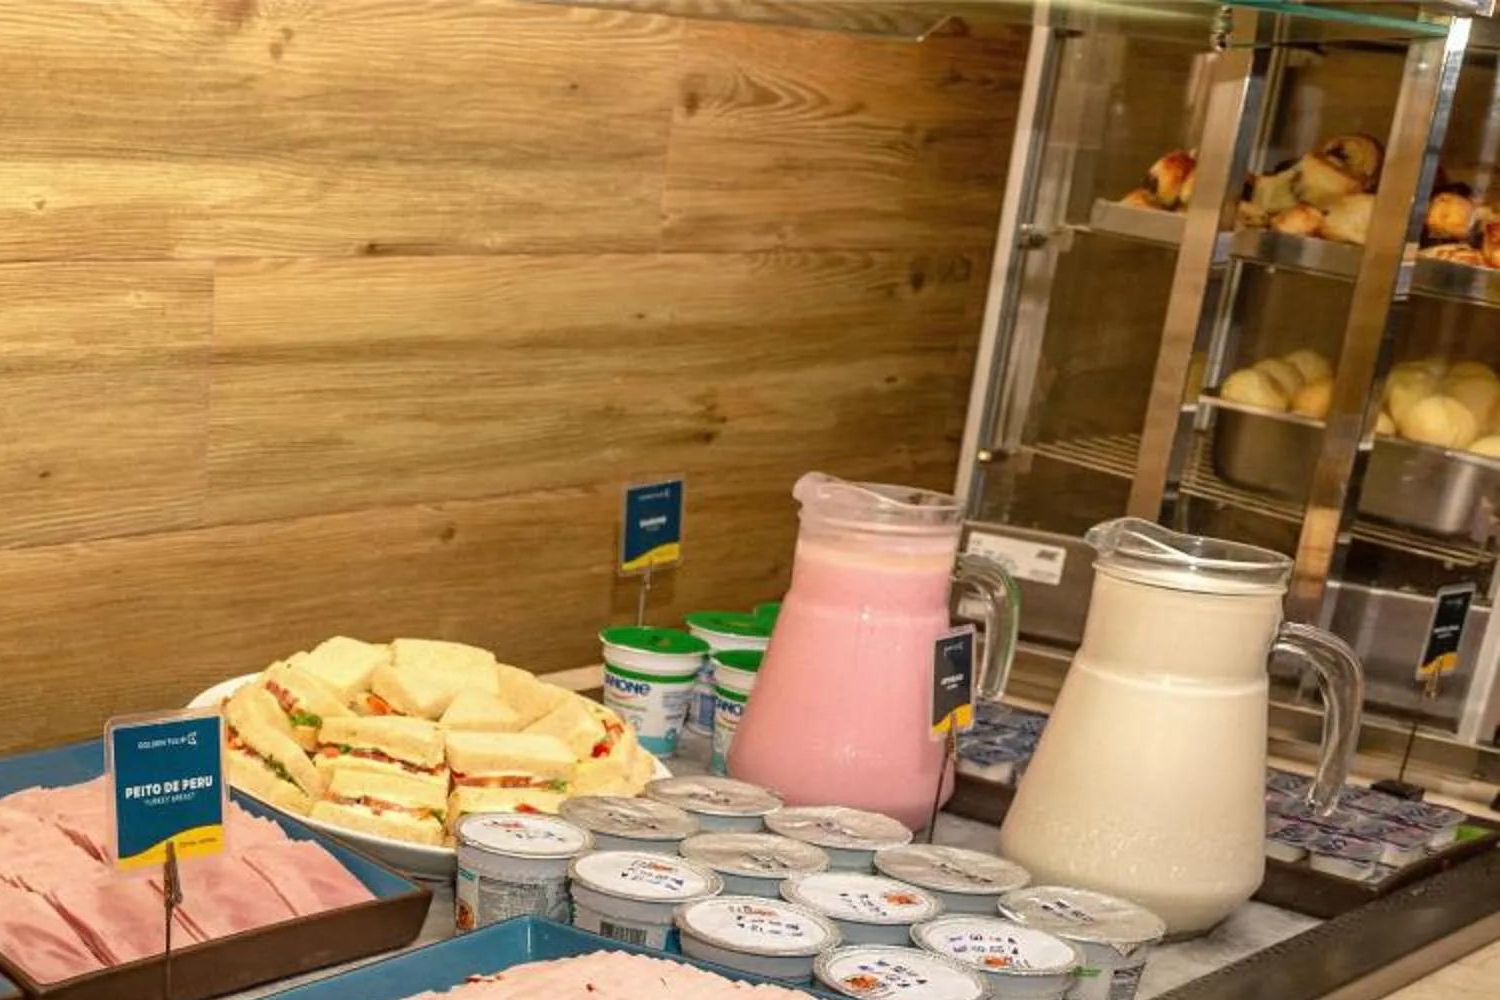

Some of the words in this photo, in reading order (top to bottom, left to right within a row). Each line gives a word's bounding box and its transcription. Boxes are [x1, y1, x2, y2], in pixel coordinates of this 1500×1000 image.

[125, 782, 162, 799] PEITO
[163, 779, 180, 794] DE
[181, 775, 213, 792] PERU
